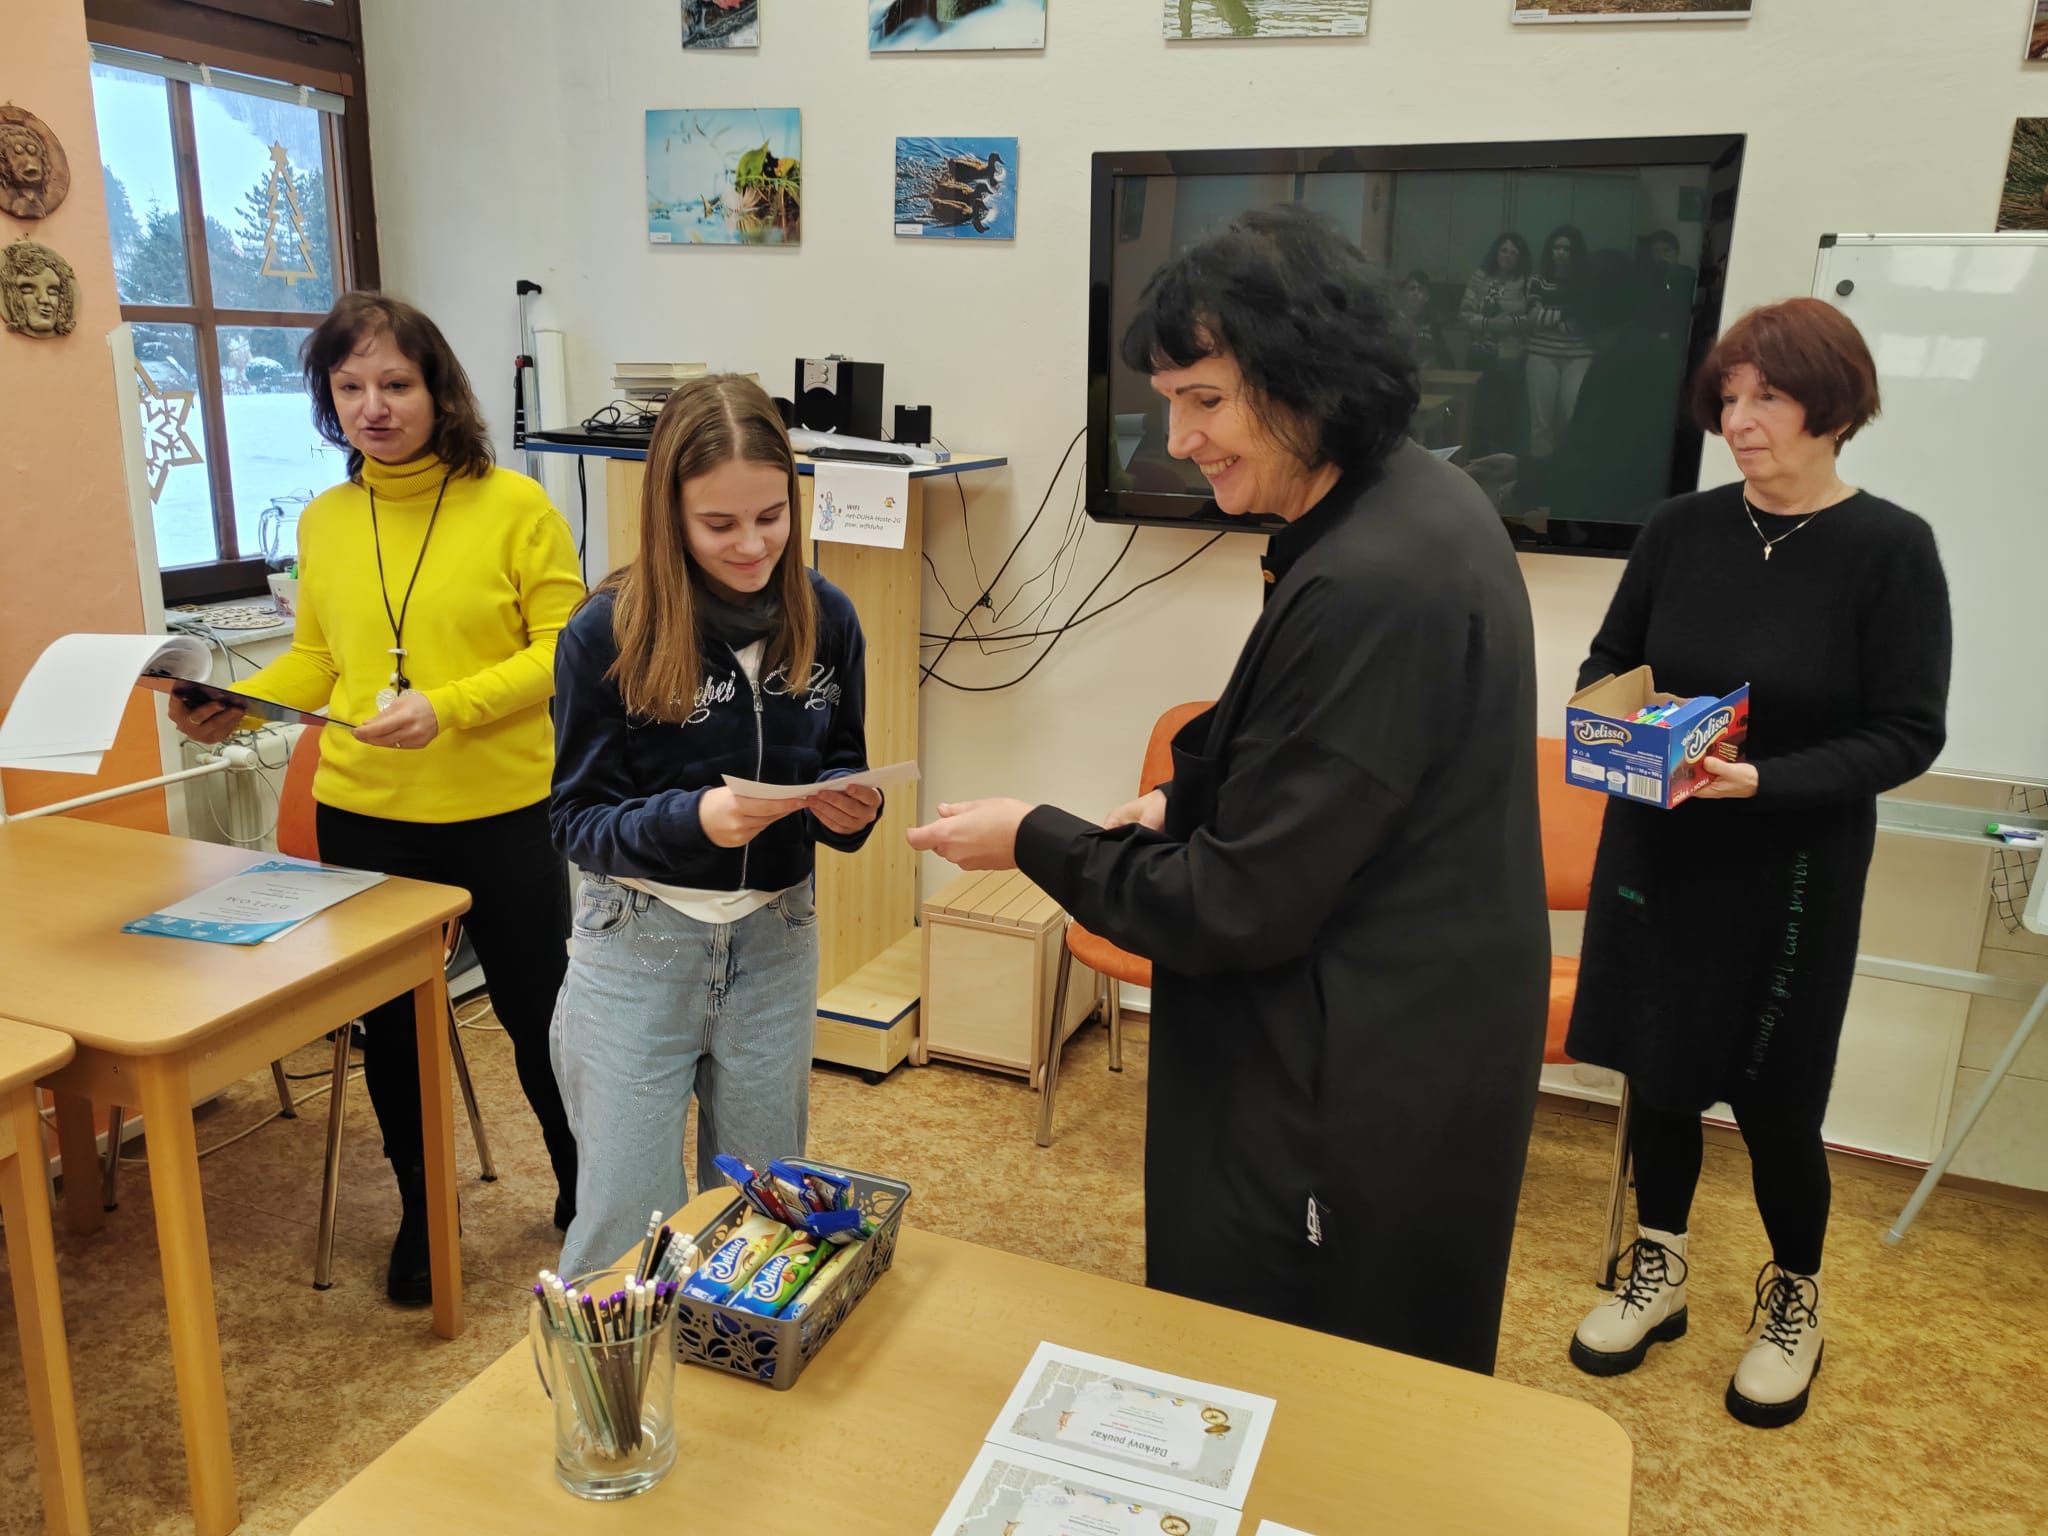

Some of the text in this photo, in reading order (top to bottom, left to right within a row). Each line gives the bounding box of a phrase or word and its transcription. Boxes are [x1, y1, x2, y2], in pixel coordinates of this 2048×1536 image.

[1577, 721, 1627, 741] Delissa
[1688, 711, 1731, 757] Delissa
[710, 1237, 747, 1279] Delissa
[752, 1255, 790, 1298] Delissa
[1090, 1430, 1169, 1458] Dárkový poukaz
